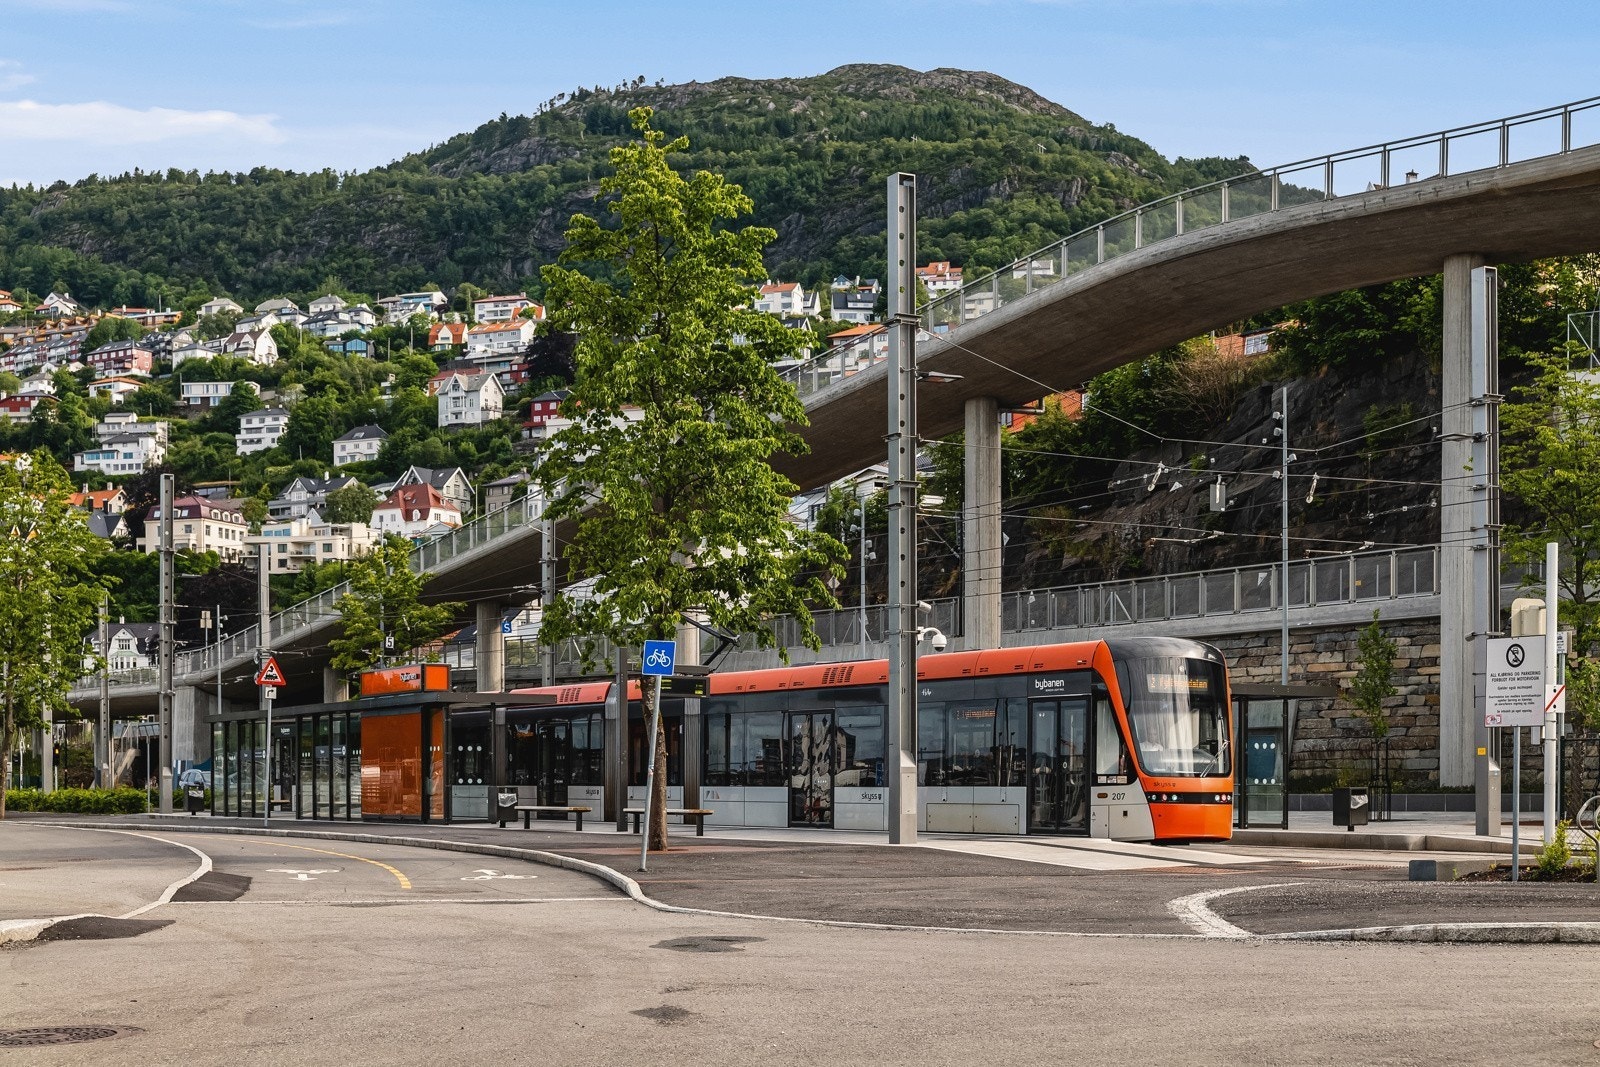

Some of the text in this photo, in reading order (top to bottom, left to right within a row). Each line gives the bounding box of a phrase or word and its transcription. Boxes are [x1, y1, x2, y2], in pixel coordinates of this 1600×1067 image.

[503, 623, 510, 632] S
[387, 638, 393, 648] 5
[1035, 678, 1064, 690] bybanen
[862, 792, 877, 801] skyss
